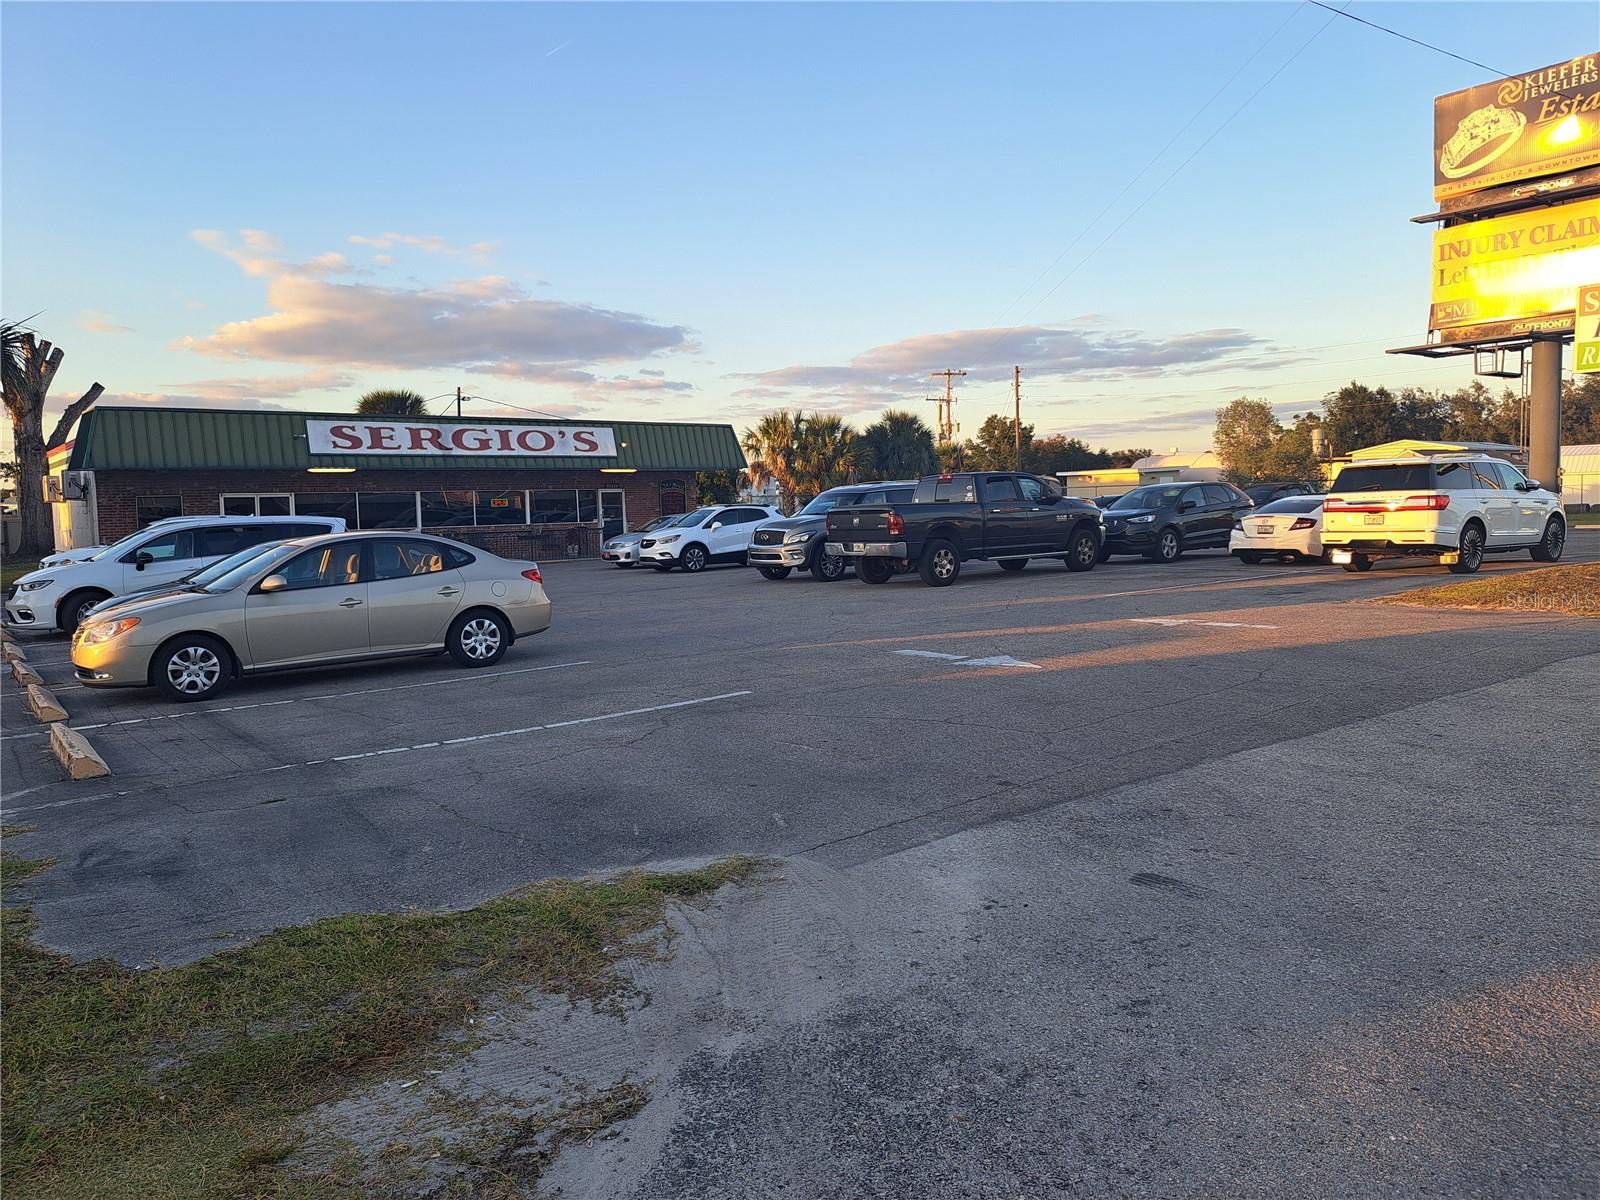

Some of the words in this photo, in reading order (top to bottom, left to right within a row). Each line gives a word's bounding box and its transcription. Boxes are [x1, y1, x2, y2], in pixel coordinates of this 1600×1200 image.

[1523, 71, 1599, 102] JEWELERS
[1525, 58, 1598, 88] KIEFER
[1500, 169, 1522, 180] LUTZ
[1538, 153, 1599, 171] DOWNTOWN
[1438, 229, 1525, 262] INJURY
[329, 425, 599, 452] SERGIO'S
